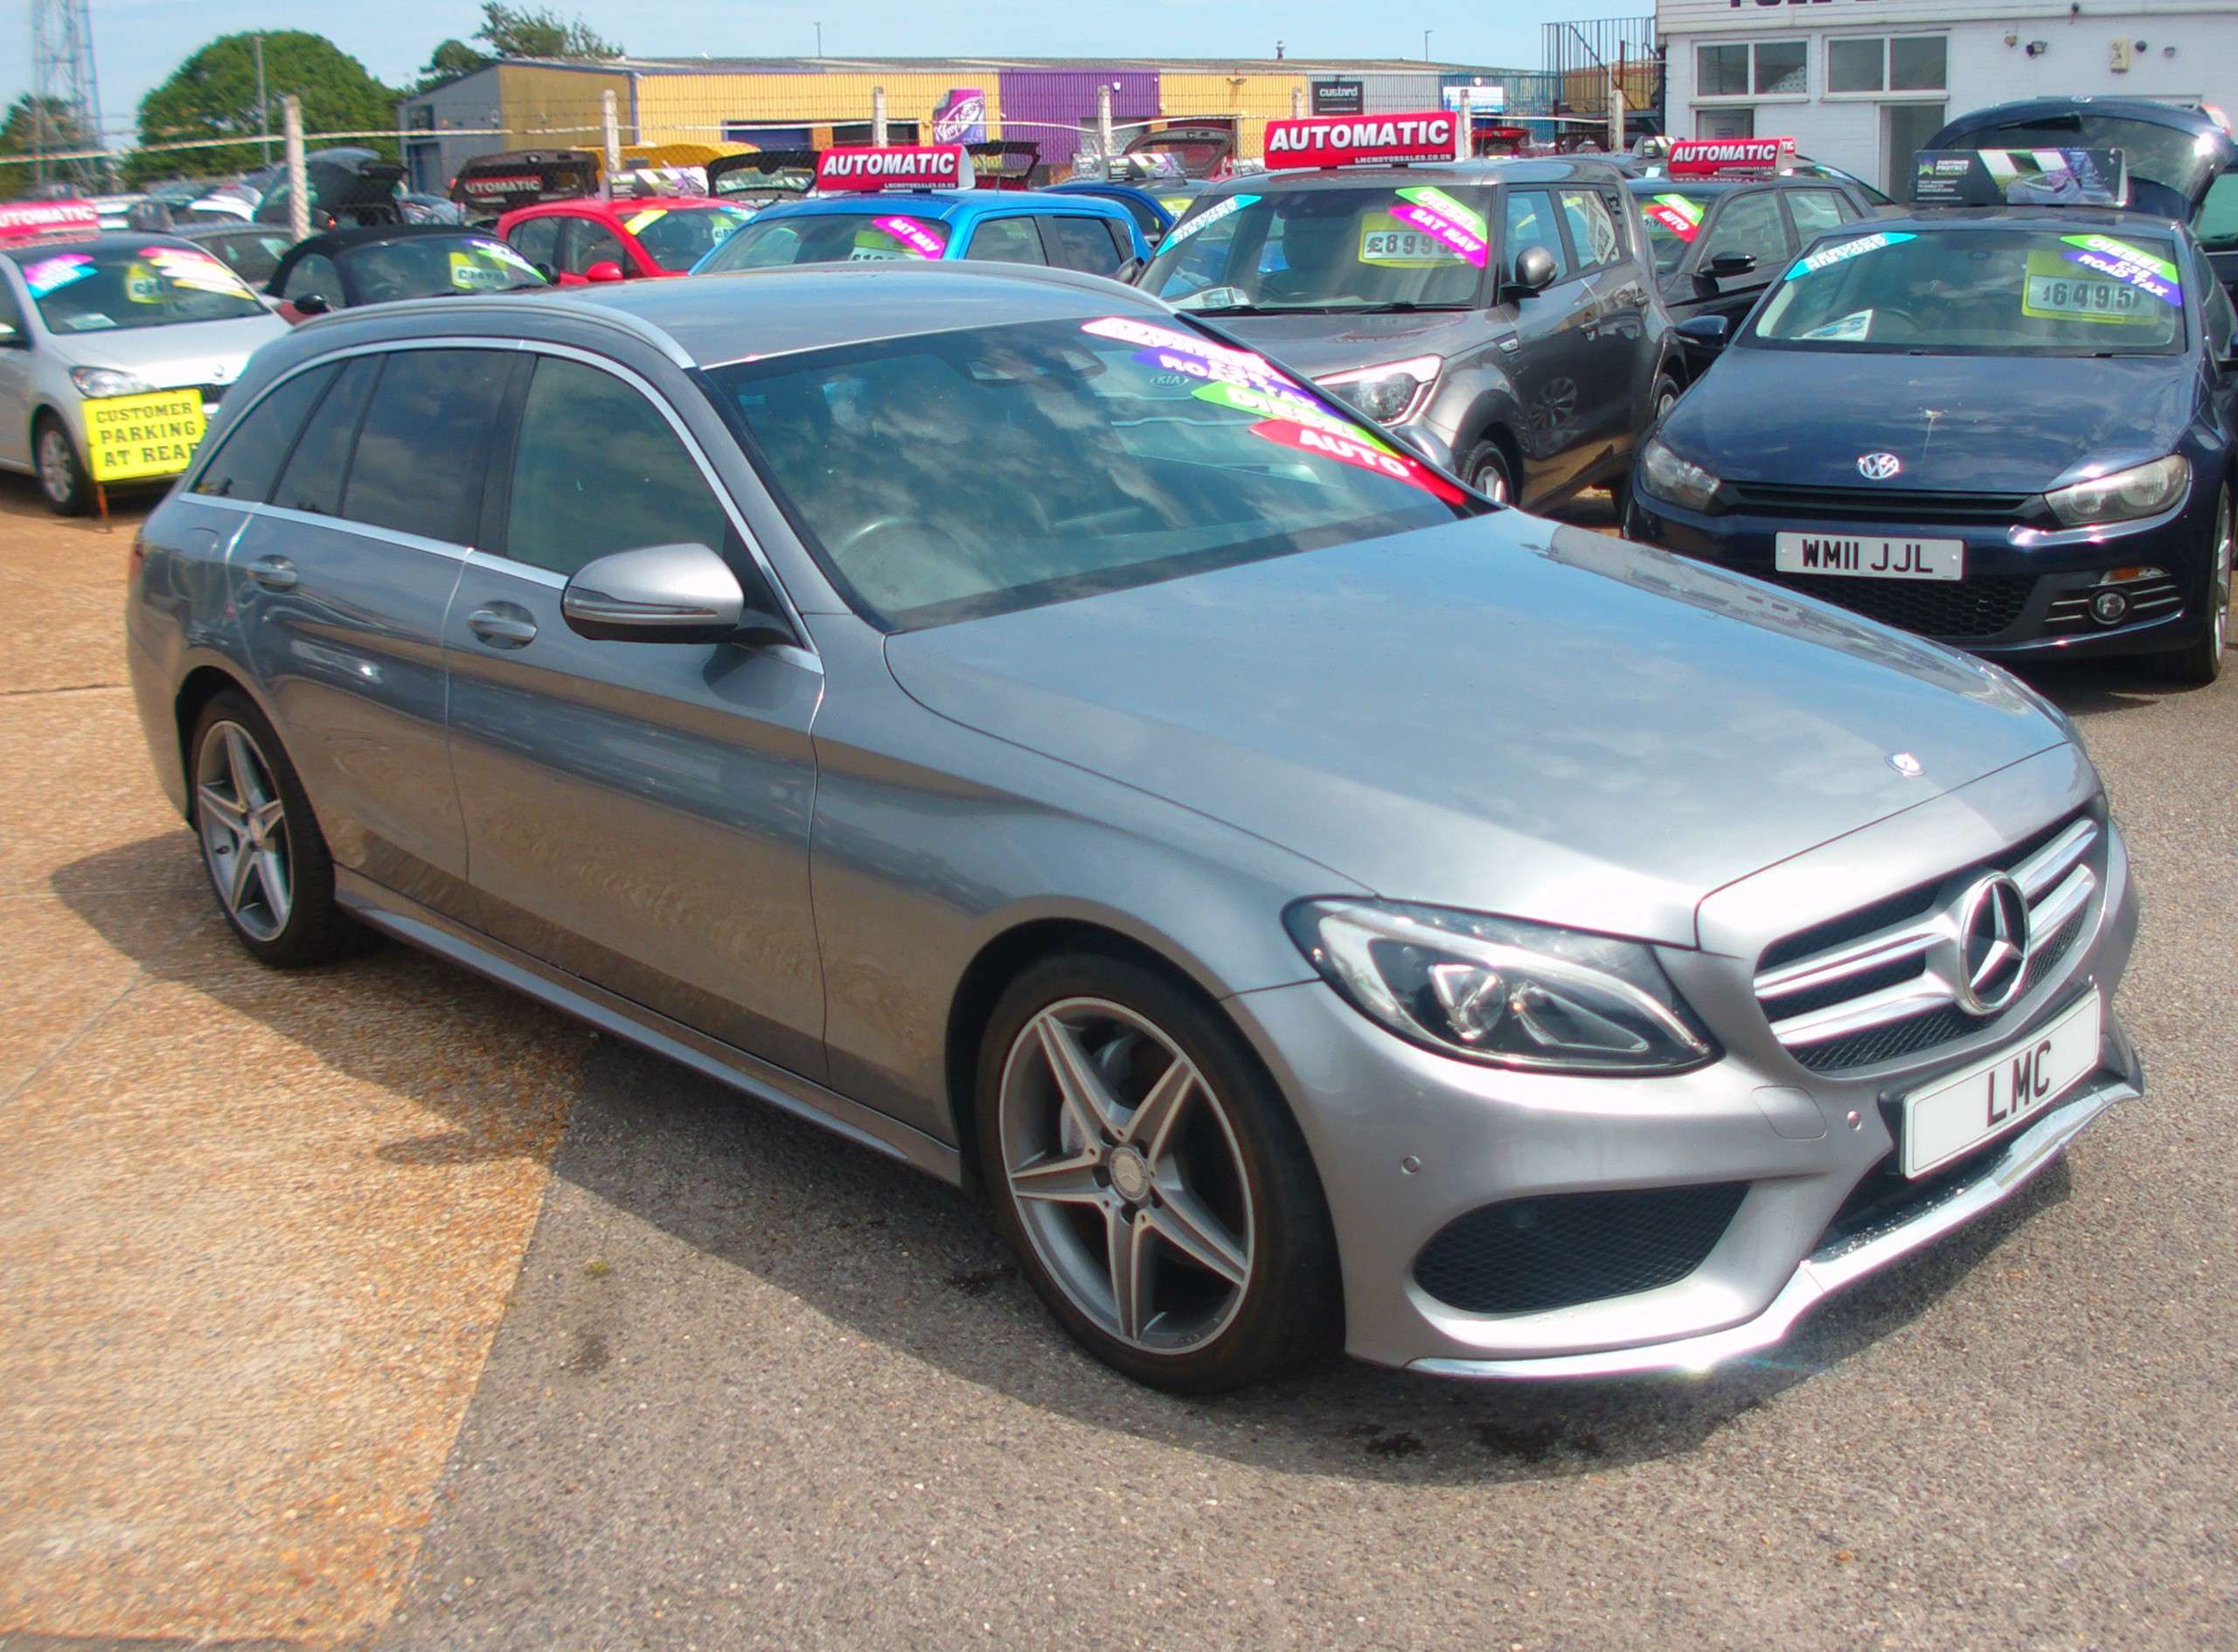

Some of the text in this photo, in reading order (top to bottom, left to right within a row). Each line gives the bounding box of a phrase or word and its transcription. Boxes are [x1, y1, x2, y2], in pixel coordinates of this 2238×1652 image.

[1319, 87, 1358, 97] custard
[1268, 119, 1449, 152] AUTOMATIC
[822, 152, 956, 176] AUTOMATIC
[1672, 144, 1776, 163] AUTOMATIC
[464, 181, 539, 194] UTOMATIC
[0, 206, 95, 227] UTOMATIC
[1659, 210, 1690, 231] AUTO
[888, 218, 940, 253] SAT NAV
[1409, 209, 1484, 252] SAT NAV
[2085, 238, 2164, 274] DIESEL
[2077, 253, 2170, 297] ROAD TAX
[1157, 374, 1181, 385] KIA
[95, 402, 192, 424] CUSTOMER
[100, 420, 196, 445] PARKING
[104, 449, 130, 468] AT
[1299, 428, 1411, 477] AUTO
[1801, 538, 1934, 574] WM11 JJL
[1986, 1039, 2053, 1128] LMC
